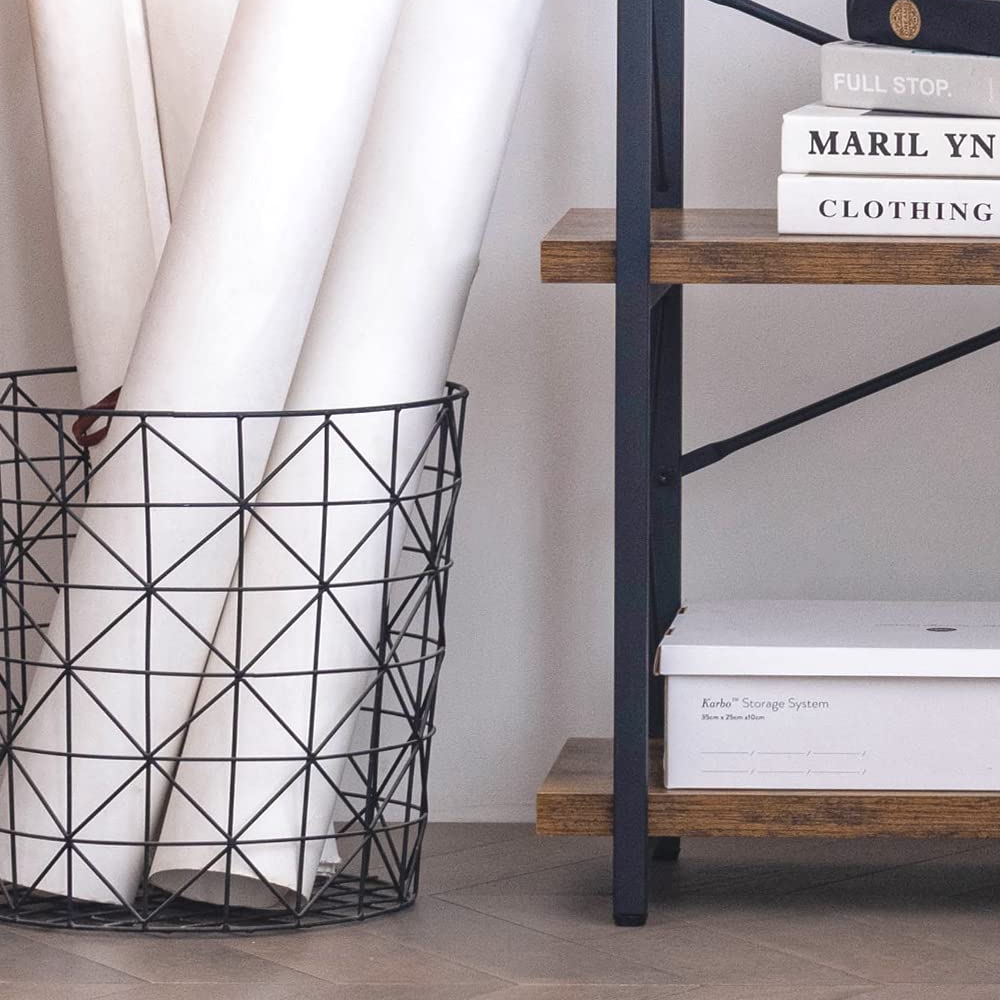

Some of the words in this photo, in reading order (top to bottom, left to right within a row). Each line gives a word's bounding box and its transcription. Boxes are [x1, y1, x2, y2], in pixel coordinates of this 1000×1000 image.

[833, 72, 887, 93] FULL
[892, 76, 952, 97] STOP.
[807, 130, 929, 157] MARIL
[943, 133, 996, 160] YN
[818, 199, 993, 222] CLOTHING
[741, 697, 786, 712] Storage
[787, 697, 830, 712] System
